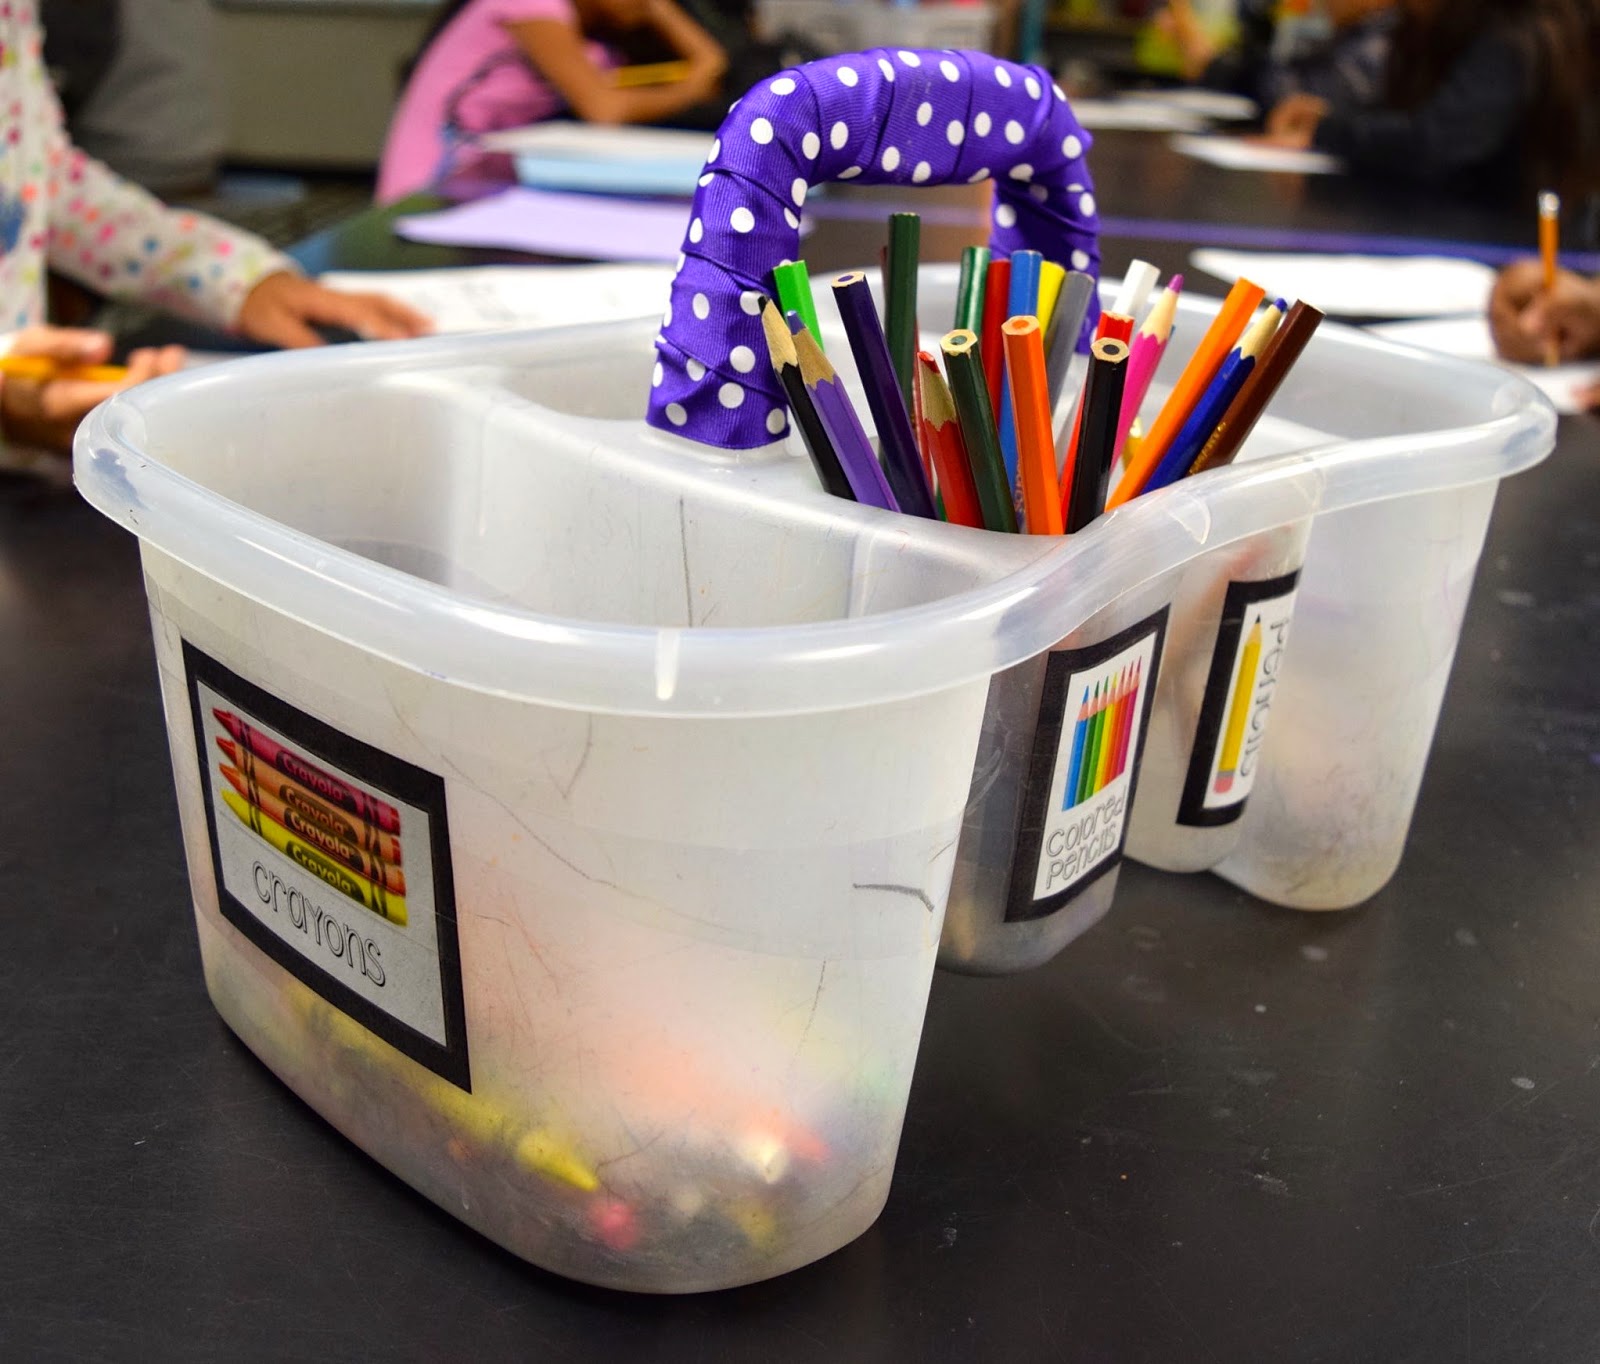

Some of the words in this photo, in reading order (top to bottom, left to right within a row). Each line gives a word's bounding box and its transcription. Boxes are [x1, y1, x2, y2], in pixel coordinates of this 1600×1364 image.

[282, 753, 344, 801] Crayola
[286, 787, 346, 835] Crayola
[290, 810, 352, 860] Crayola
[292, 845, 353, 893] Crayola
[252, 860, 387, 988] crayons
